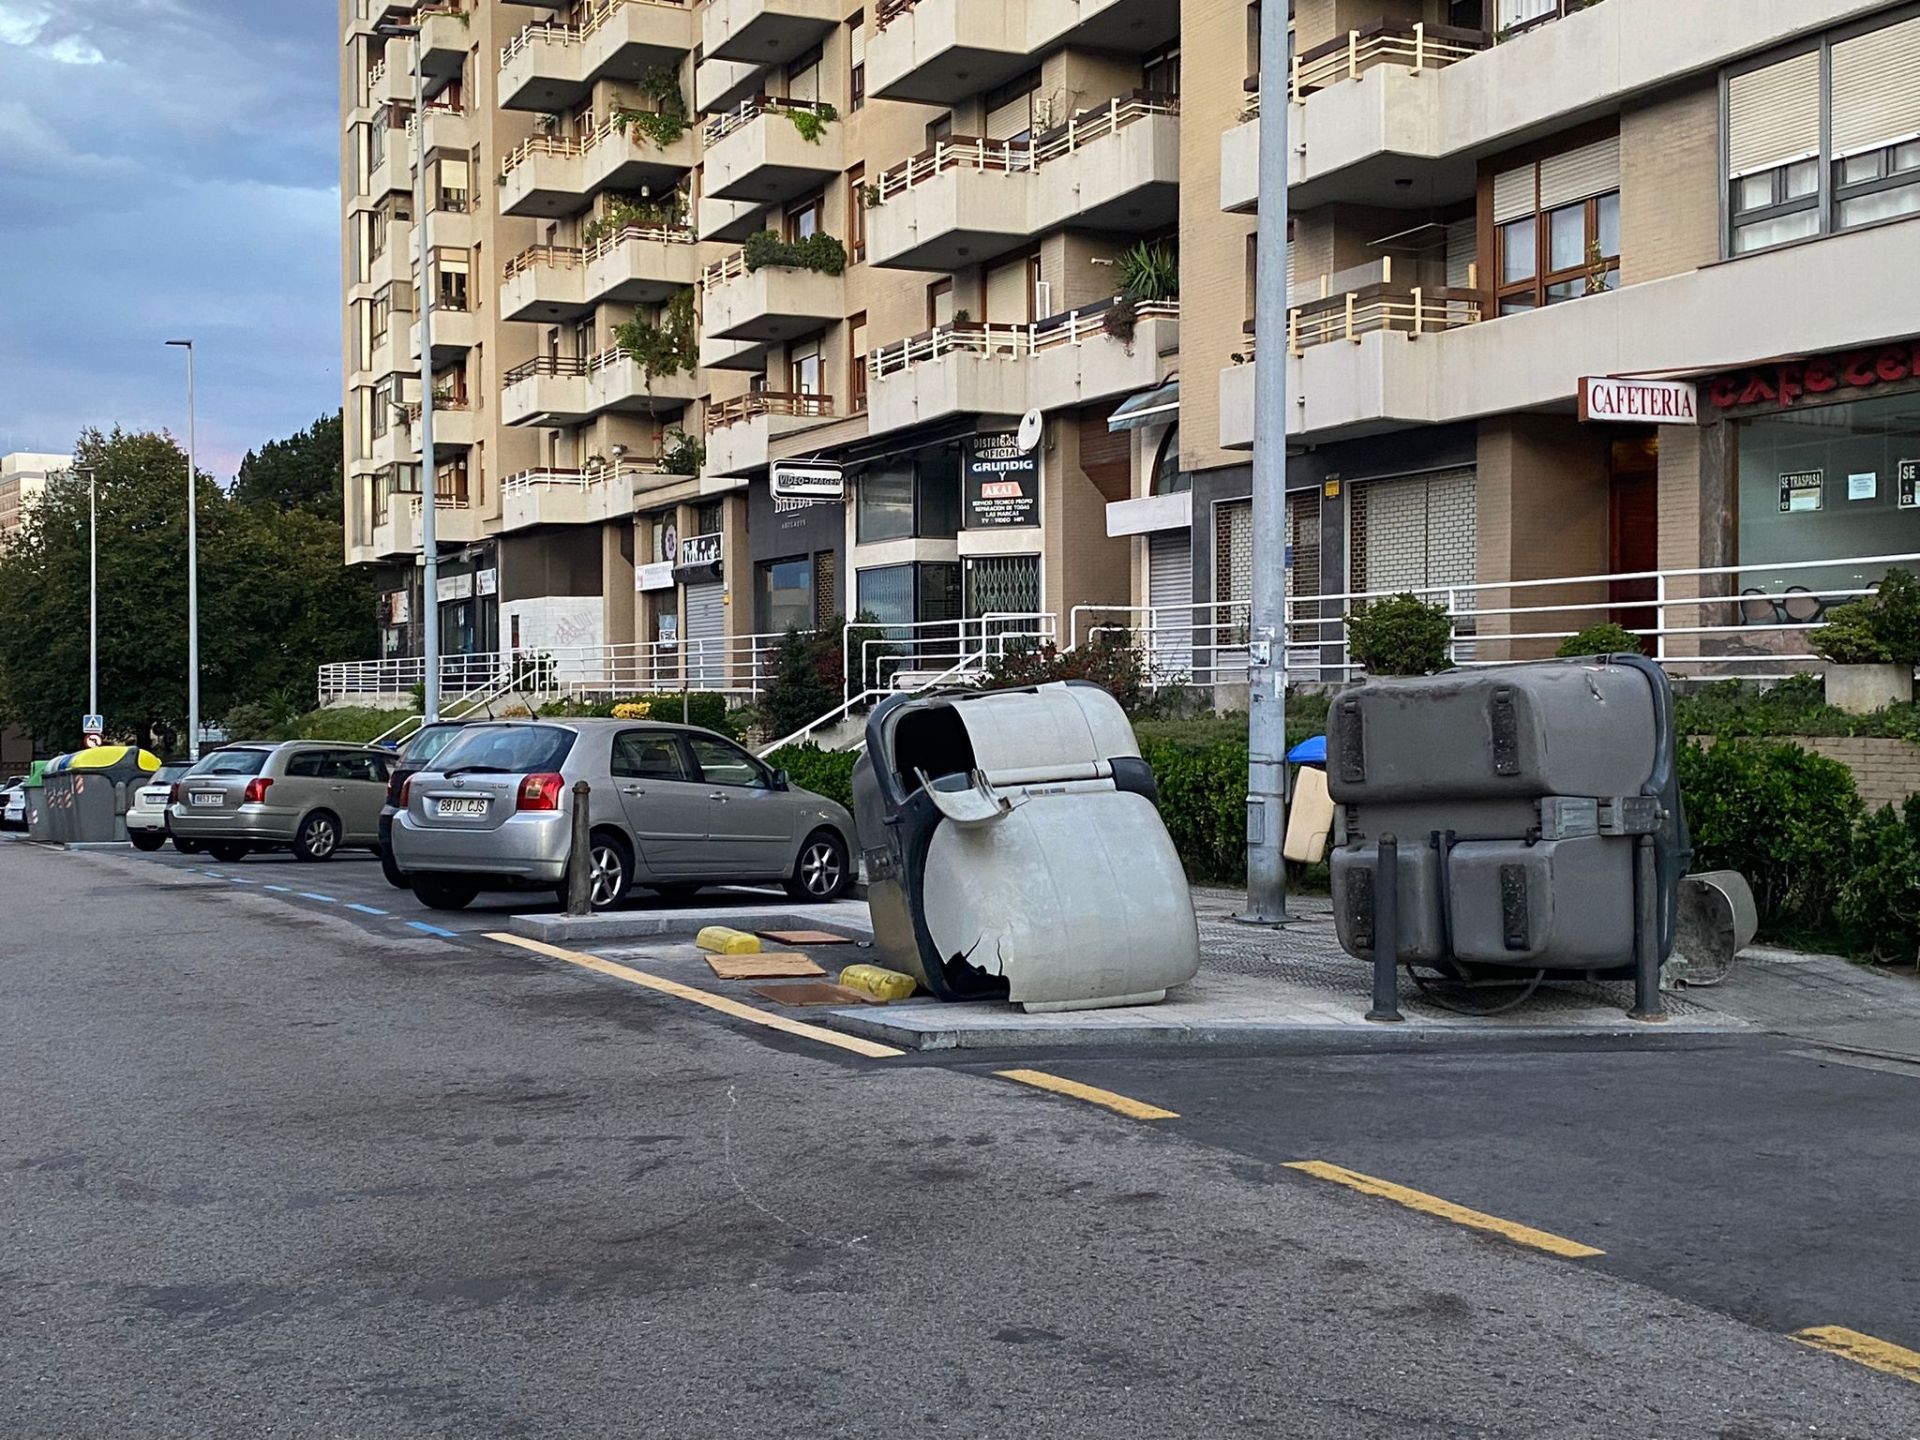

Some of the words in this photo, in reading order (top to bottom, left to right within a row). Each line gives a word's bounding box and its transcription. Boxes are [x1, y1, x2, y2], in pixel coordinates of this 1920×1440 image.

[1592, 384, 1694, 418] CAFETERIA
[972, 460, 1033, 472] GRUNDIG
[1902, 465, 1916, 480] SE
[999, 471, 1006, 481] Y
[1781, 476, 1789, 488] SE
[1790, 473, 1821, 487] TRASPASA
[984, 484, 1012, 496] AKAI
[440, 799, 463, 812] 8810
[468, 799, 485, 812] CJS
